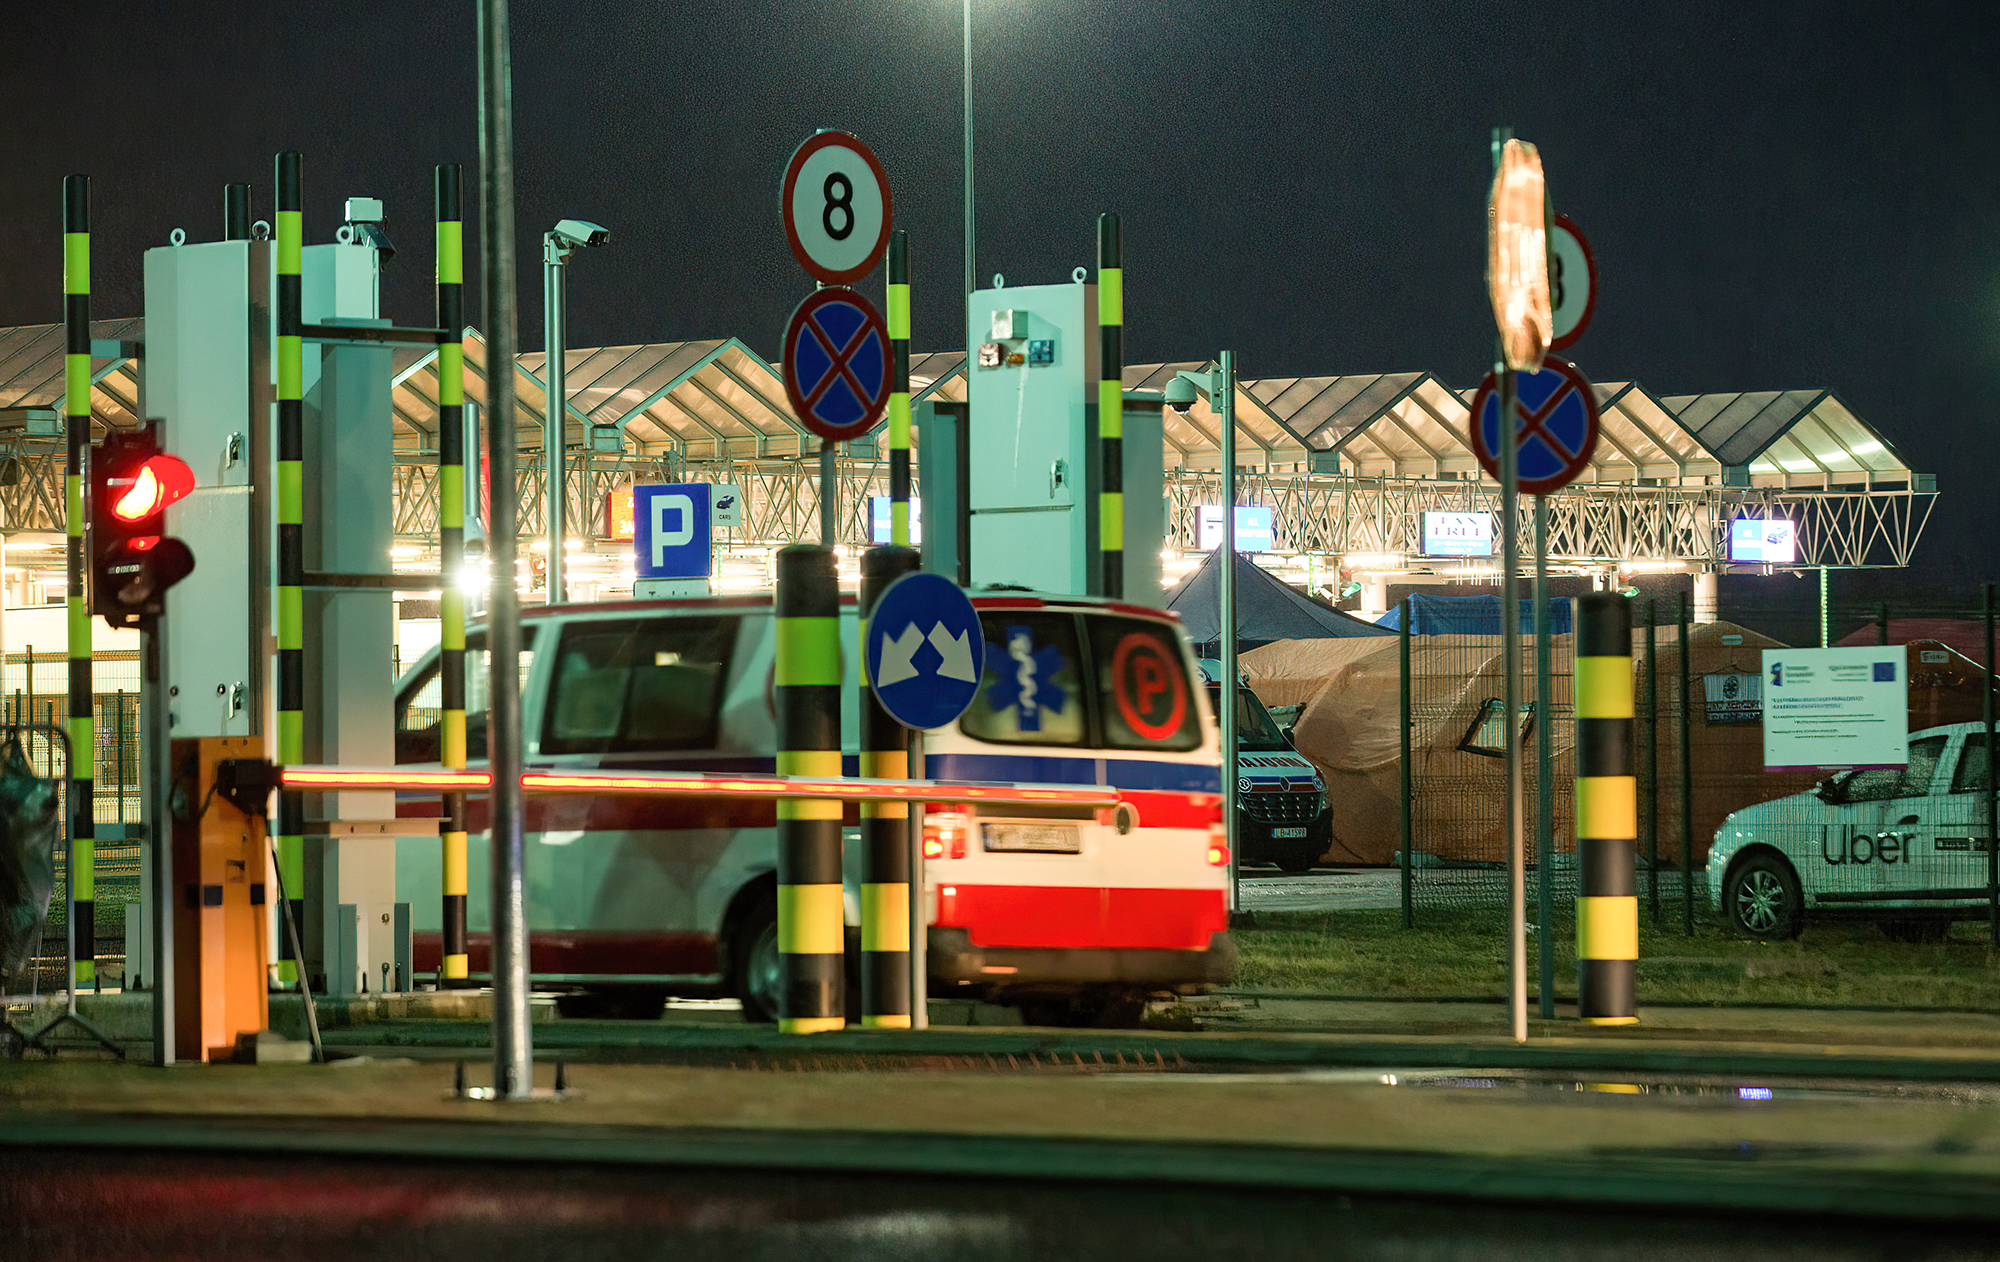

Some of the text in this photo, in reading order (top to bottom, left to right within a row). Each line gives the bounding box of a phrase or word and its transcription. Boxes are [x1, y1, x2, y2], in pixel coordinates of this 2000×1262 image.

[823, 171, 854, 241] 8
[651, 494, 694, 567] P
[1134, 655, 1167, 715] P
[1823, 824, 1917, 866] Uber
